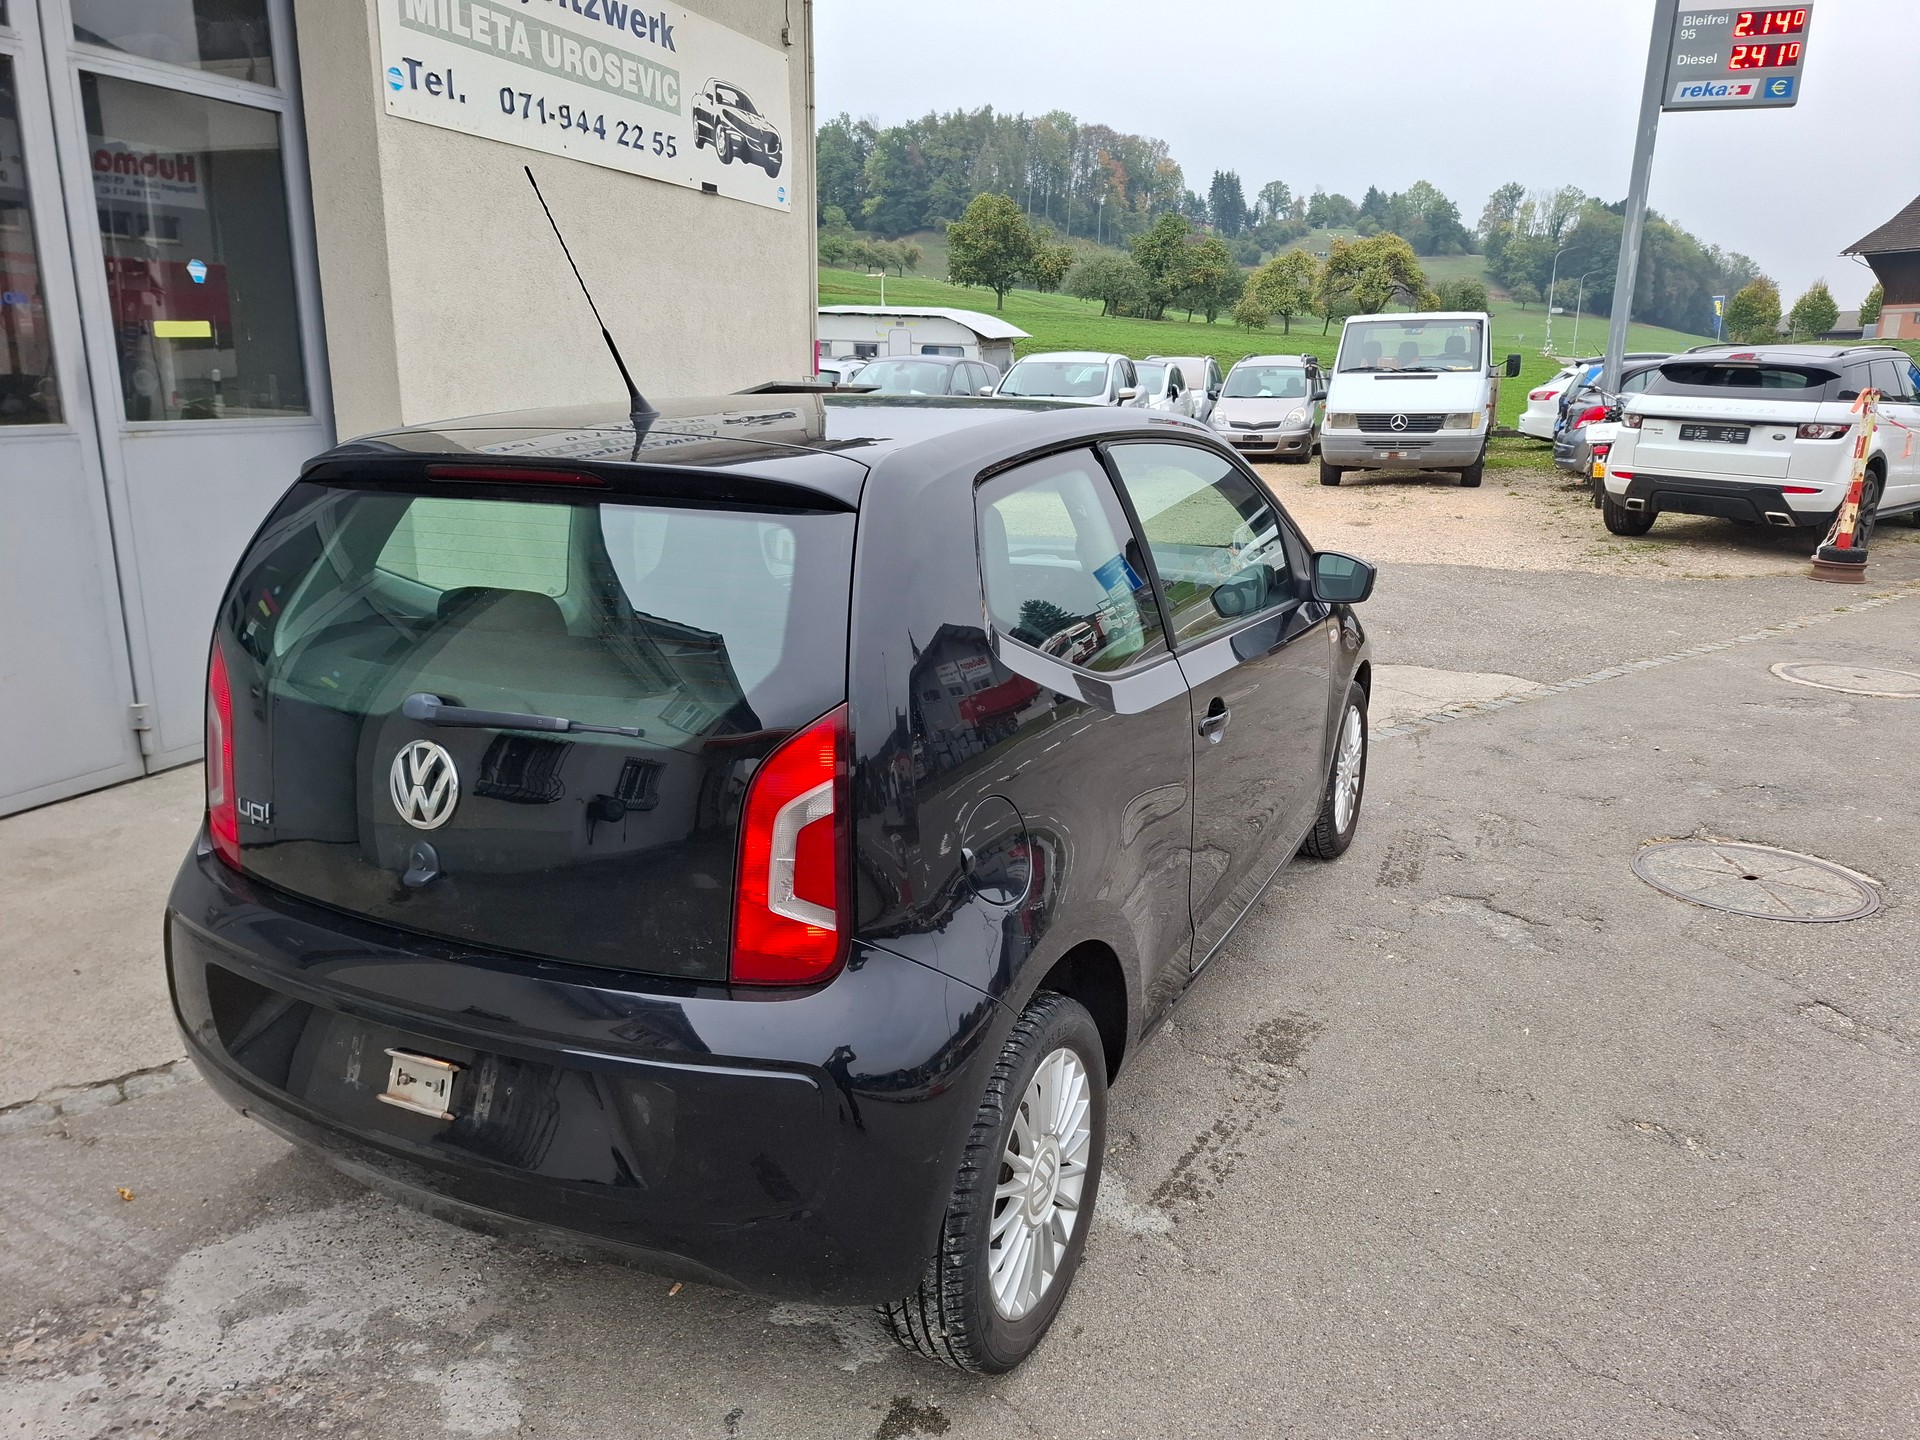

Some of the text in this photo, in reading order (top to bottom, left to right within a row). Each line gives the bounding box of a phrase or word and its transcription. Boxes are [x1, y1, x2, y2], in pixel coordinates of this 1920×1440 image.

[1680, 29, 1697, 40] 95
[1682, 10, 1806, 37] Bleifrei 2.140
[403, 0, 679, 108] MILETA UROSEVIC
[1677, 43, 1800, 69] Diesel 2.410
[402, 57, 466, 104] Tel.
[500, 87, 606, 140] 071-944
[616, 120, 645, 151] 22
[652, 131, 677, 158] 55
[238, 797, 271, 825] up!
